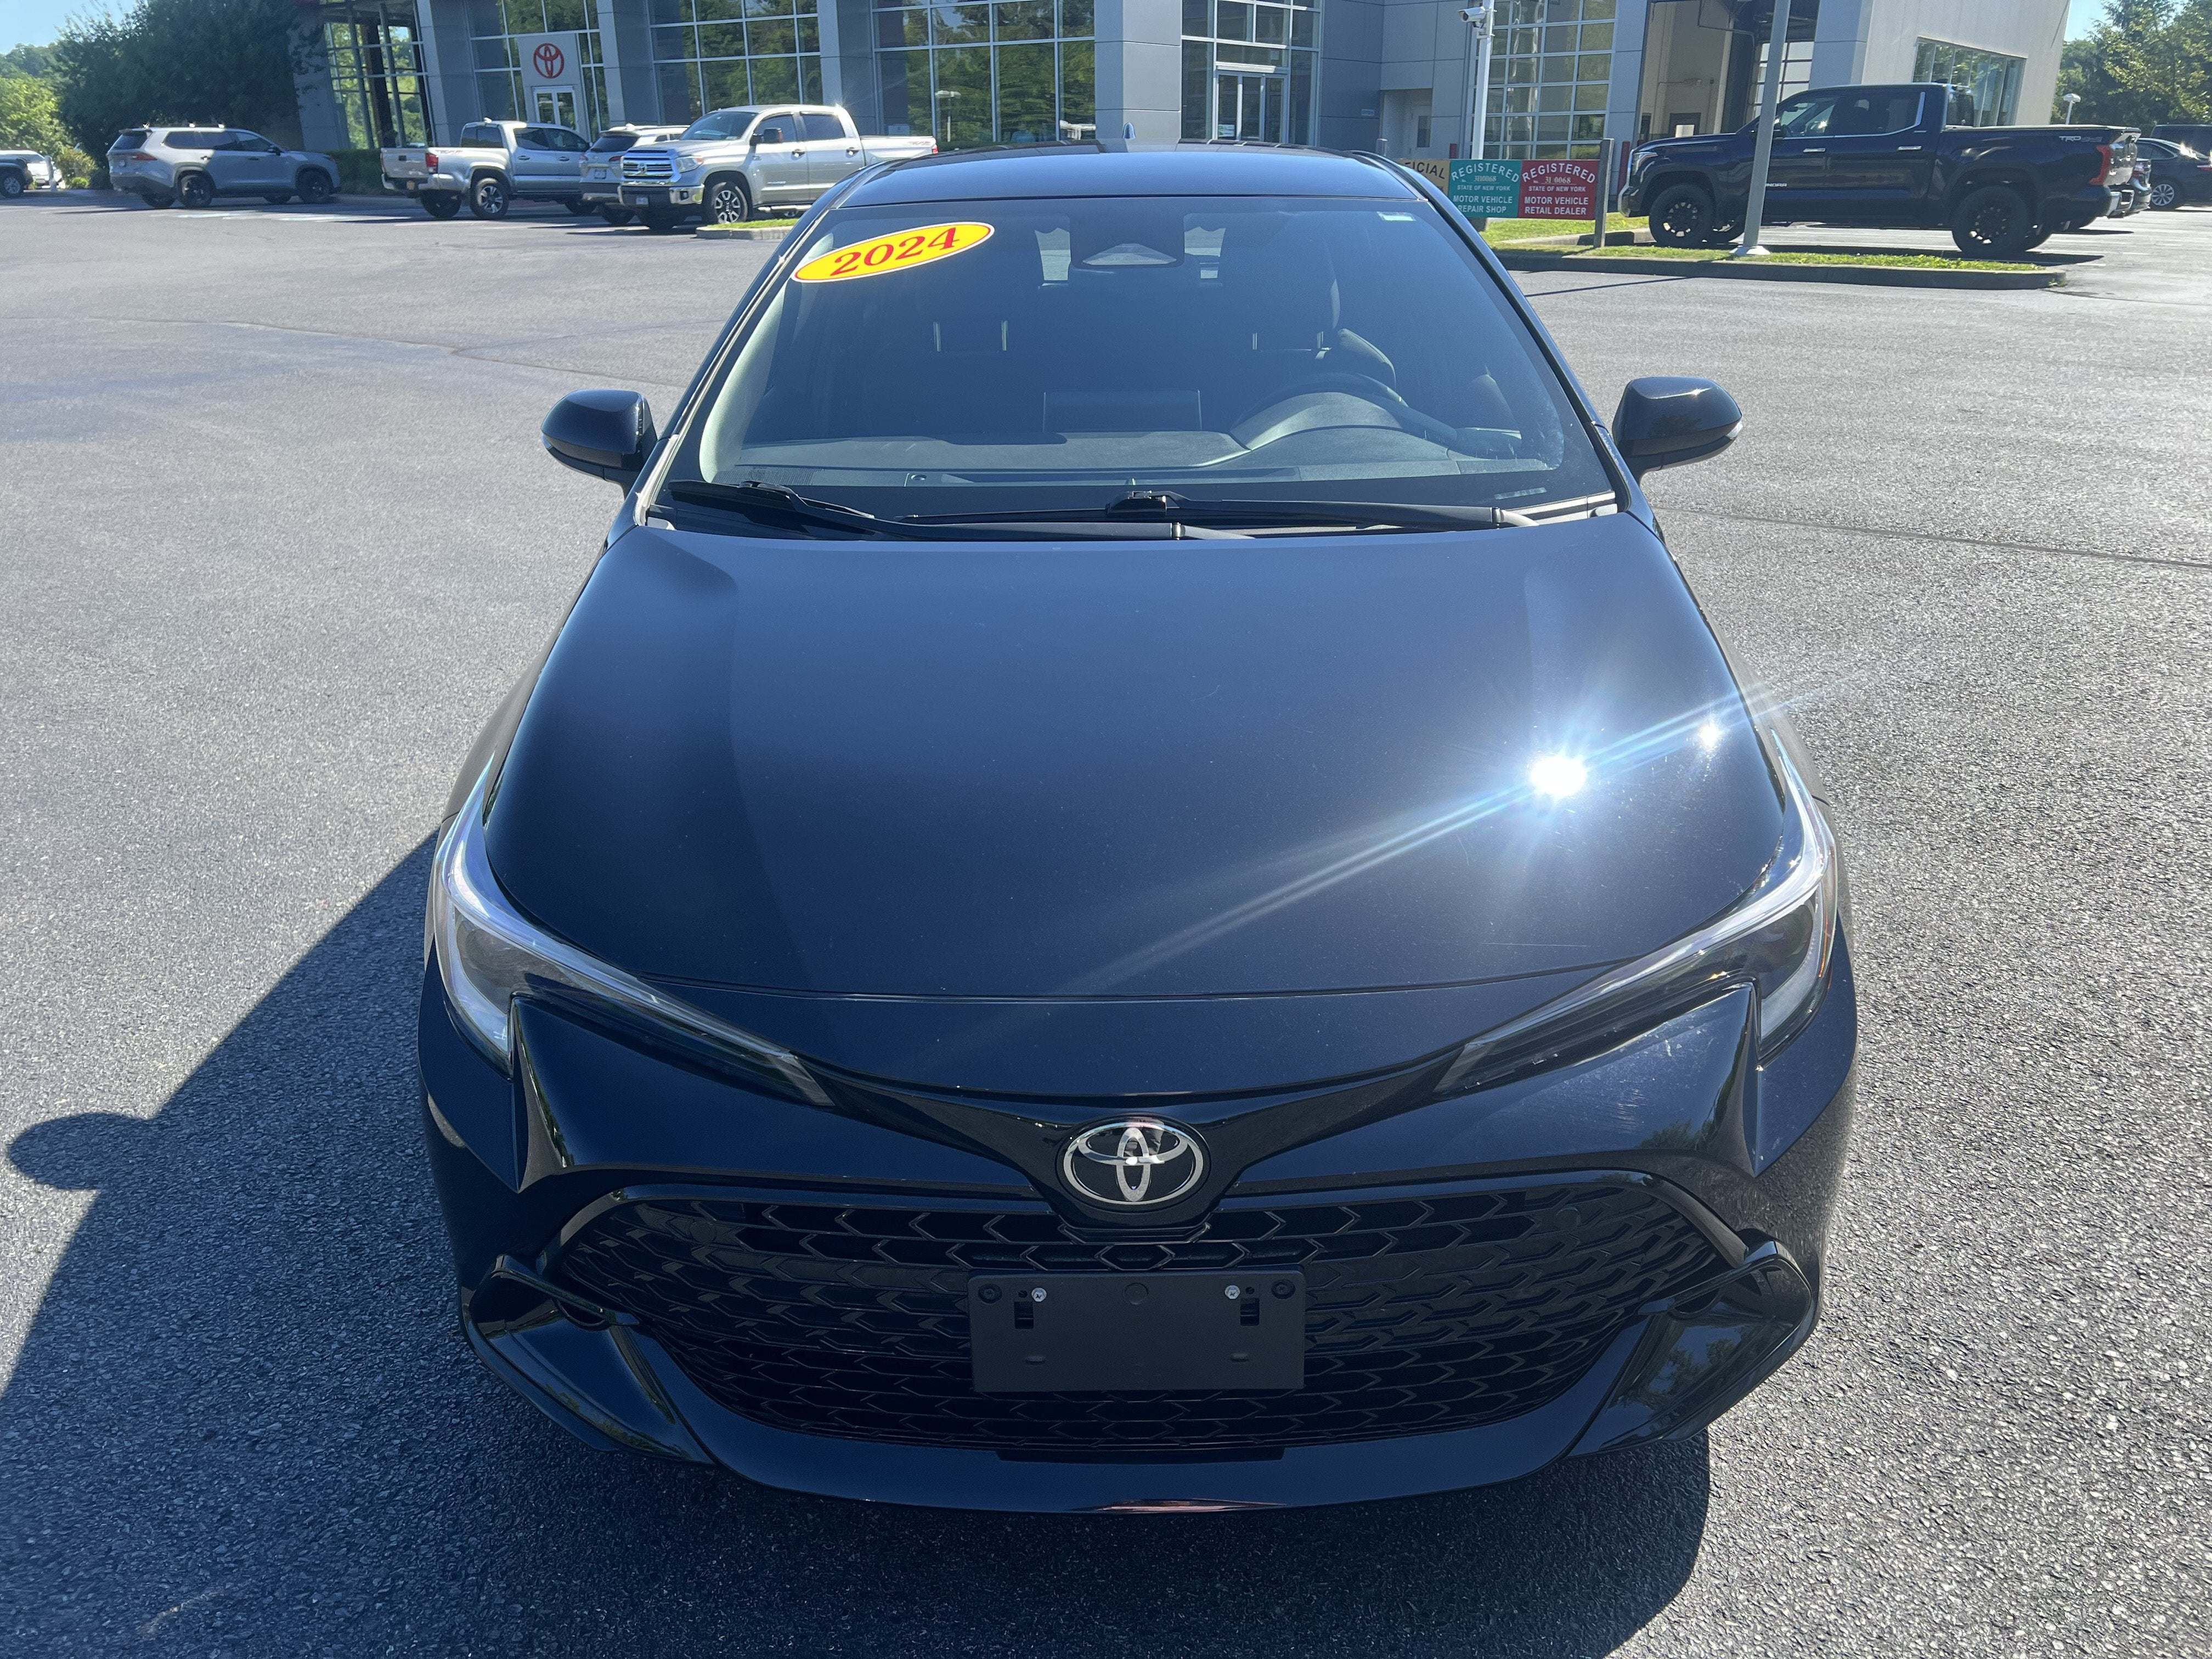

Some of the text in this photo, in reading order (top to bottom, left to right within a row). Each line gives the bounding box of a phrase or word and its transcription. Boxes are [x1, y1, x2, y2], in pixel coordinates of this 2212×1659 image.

[1405, 162, 1445, 179] ICIAL
[1451, 163, 1519, 183] REGISTERED
[1522, 163, 1596, 183] REGISTERED
[1453, 195, 1513, 204] MOTOR VEHICLE
[1486, 205, 1506, 213] SHOP
[1554, 207, 1587, 215] DEALER
[830, 227, 960, 276] 2024
